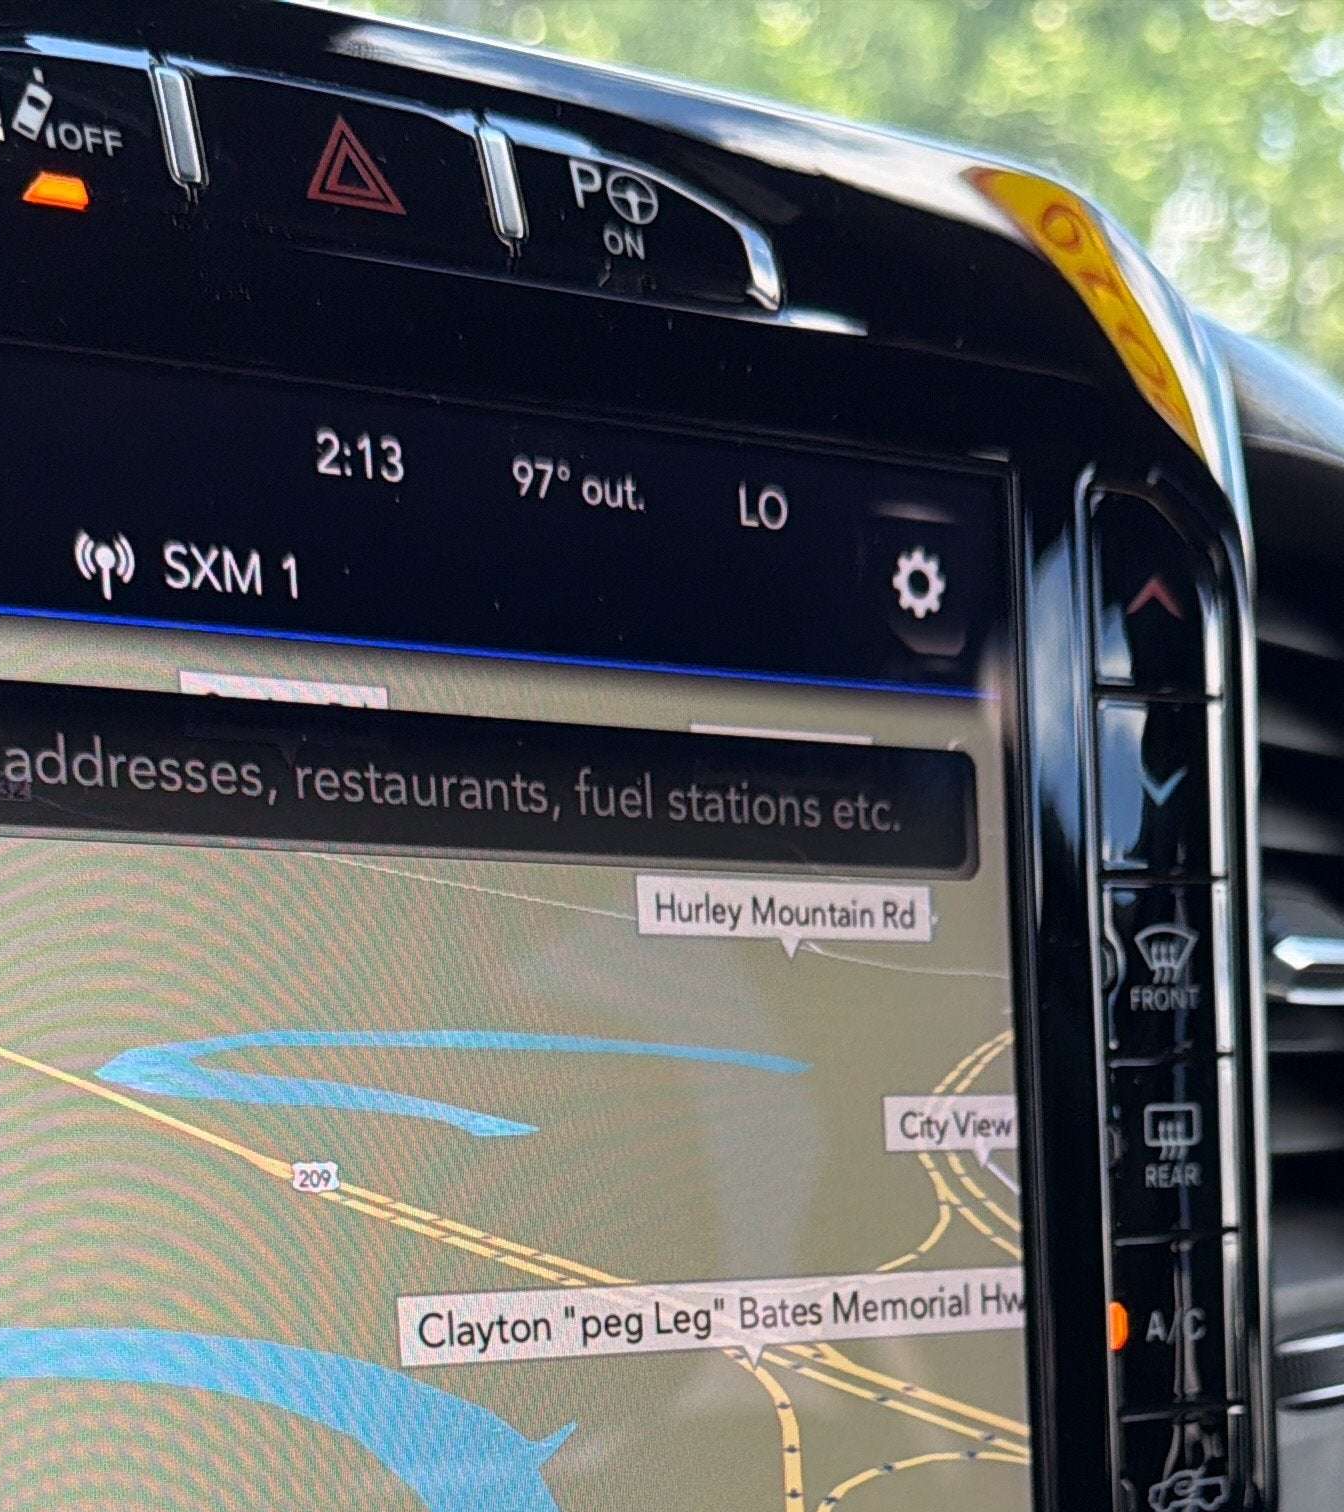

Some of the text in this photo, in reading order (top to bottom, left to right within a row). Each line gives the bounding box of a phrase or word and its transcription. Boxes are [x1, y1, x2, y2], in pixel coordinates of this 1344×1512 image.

[60, 121, 124, 157] OFF
[602, 225, 646, 260] ON
[314, 427, 406, 484] 2:13
[511, 453, 646, 513] 97° out.
[737, 481, 790, 531] LO
[163, 539, 300, 600] SXM 1
[3, 730, 278, 806] addresses,
[294, 758, 563, 824] restaurants,
[575, 764, 654, 820] fuel
[667, 778, 822, 829] stations
[832, 786, 902, 833] etc.
[654, 891, 917, 932] Hurley Mountain Rd
[1129, 984, 1200, 1012] FRONT
[899, 1108, 1014, 1146] City View
[297, 1166, 332, 1190] 209
[1144, 1163, 1202, 1189] REAR
[417, 1309, 552, 1354] Clayton
[564, 1303, 645, 1346] "peg
[654, 1297, 725, 1343] Leg"
[738, 1294, 823, 1331] Bates
[832, 1281, 972, 1327] Memorial
[1145, 1307, 1208, 1345] A/C
